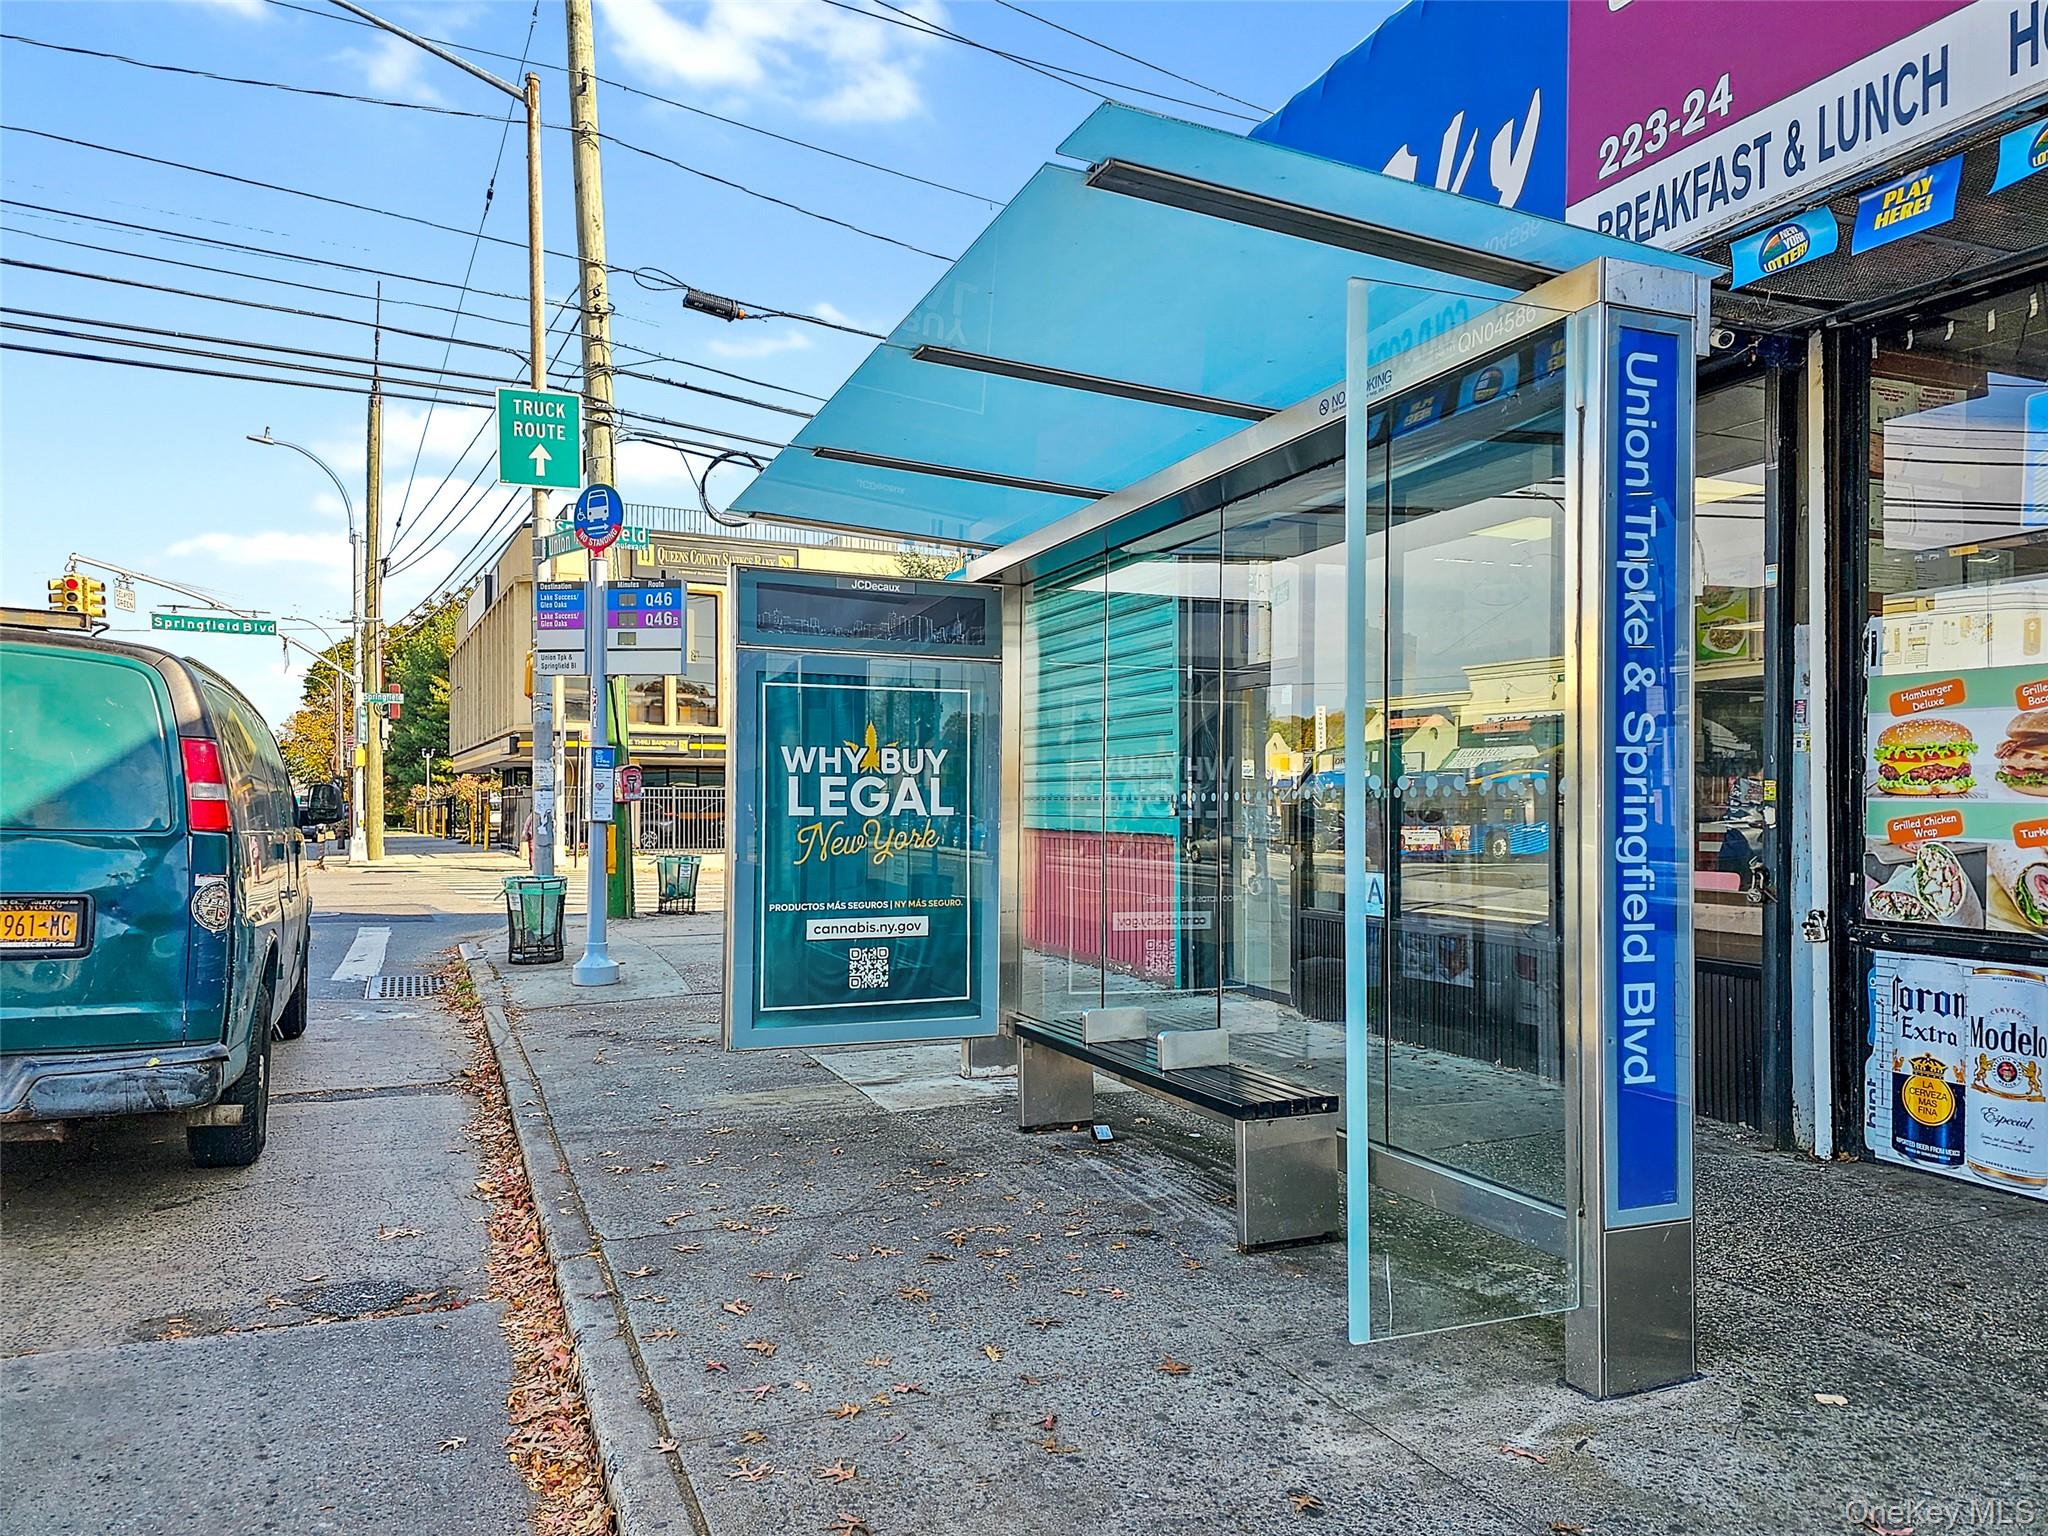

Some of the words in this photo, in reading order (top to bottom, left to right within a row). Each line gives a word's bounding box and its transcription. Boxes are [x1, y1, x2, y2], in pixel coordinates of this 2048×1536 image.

[1784, 119, 1806, 178] &
[1818, 44, 1949, 163] LUNCH
[2010, 1, 2048, 77] H
[1598, 72, 1734, 181] 223-24
[1883, 175, 1934, 209] PLAY
[1874, 193, 1934, 231] HERE!
[1779, 225, 1798, 240] NEW
[1783, 231, 1806, 249] YORK
[1763, 240, 1808, 272] LOTTERY
[1457, 303, 1536, 353] QN04586
[1331, 391, 1346, 409] NO
[1365, 369, 1392, 393] KING
[513, 399, 566, 419] TRUCK
[1625, 351, 1659, 487] Union
[513, 421, 566, 441] ROUTE
[548, 535, 571, 556] Union
[579, 531, 587, 543] NO
[588, 527, 618, 547] STANDING
[689, 549, 722, 567] COUNTY
[1616, 504, 1657, 647] Tnpke
[851, 579, 901, 593] JCDecaux
[540, 601, 553, 609] Glen
[645, 591, 673, 607] Q46
[154, 617, 240, 632] Springfield
[243, 623, 275, 633] Blvd
[540, 619, 553, 627] Glen
[540, 662, 570, 670] Springfield
[557, 654, 568, 662] Tpk
[1623, 662, 1656, 695] &
[1900, 684, 1953, 702] Hamburger
[1912, 697, 1945, 712] Deluxe
[781, 745, 868, 774] WHY
[881, 747, 949, 775] BUY
[788, 775, 955, 817] LEGAL
[1893, 818, 1921, 831] Grilled
[1923, 814, 1957, 827] Chicken
[793, 820, 868, 865] New
[863, 818, 941, 865] York
[1616, 711, 1656, 964] Springfield
[1913, 827, 1938, 839] Wrap
[1368, 878, 1383, 904] A
[768, 903, 826, 912] PRODUCTOS
[826, 900, 847, 911] MÁS
[847, 900, 889, 910] SEGUROS
[894, 901, 907, 909] NY
[907, 898, 928, 908] MÁS
[928, 898, 964, 908] SEGURO.
[813, 920, 922, 937] cannabis.ny.gov
[1892, 974, 1965, 1022] Coron
[1623, 982, 1656, 1084] Blvd
[1902, 1015, 1957, 1047] Extra
[1970, 1015, 2047, 1059] Modelo
[1909, 1086, 1949, 1102] CERVEZA
[1922, 1080, 1934, 1090] LA
[1917, 1105, 1938, 1117] FINA
[1918, 1097, 1938, 1108] MAS
[1981, 1106, 2032, 1131] Especial
